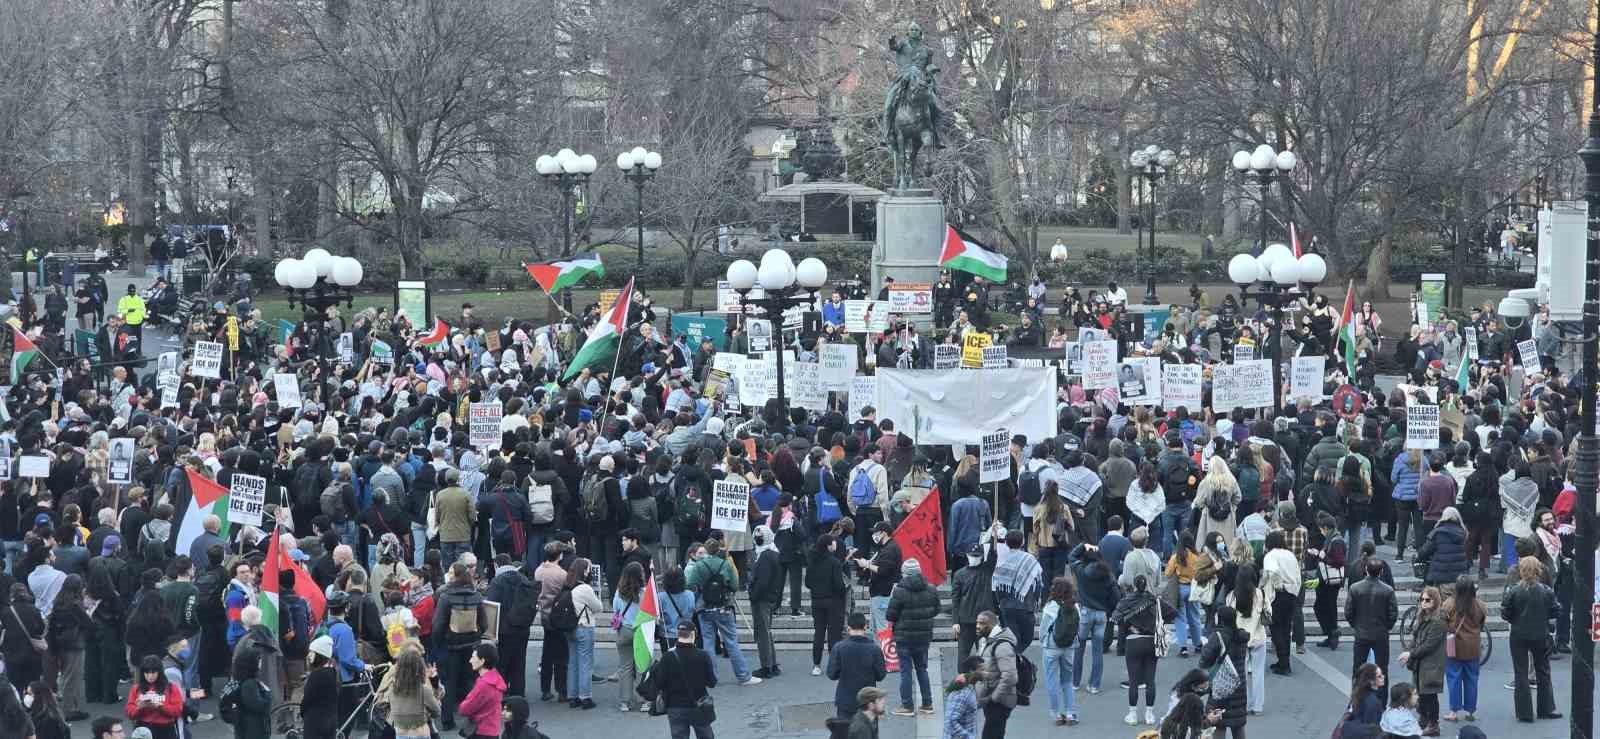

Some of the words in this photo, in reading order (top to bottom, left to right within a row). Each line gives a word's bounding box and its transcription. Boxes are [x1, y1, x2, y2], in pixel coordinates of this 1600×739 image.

[966, 335, 985, 348] ICE
[472, 408, 488, 417] FREE
[489, 408, 500, 417] ALL
[1408, 406, 1438, 415] RELEASE
[471, 424, 500, 432] POLITICAL
[983, 431, 1010, 444] RELEASE
[983, 440, 1010, 451] MAHMOUD
[983, 458, 1002, 466] HANDS
[233, 475, 264, 490] HANDS
[717, 483, 748, 494] RELEASE
[717, 491, 748, 501] MAHMOUD
[230, 498, 244, 511] ICE
[246, 502, 262, 513] OFF
[715, 506, 729, 517] ICE
[731, 508, 746, 519] OFF
